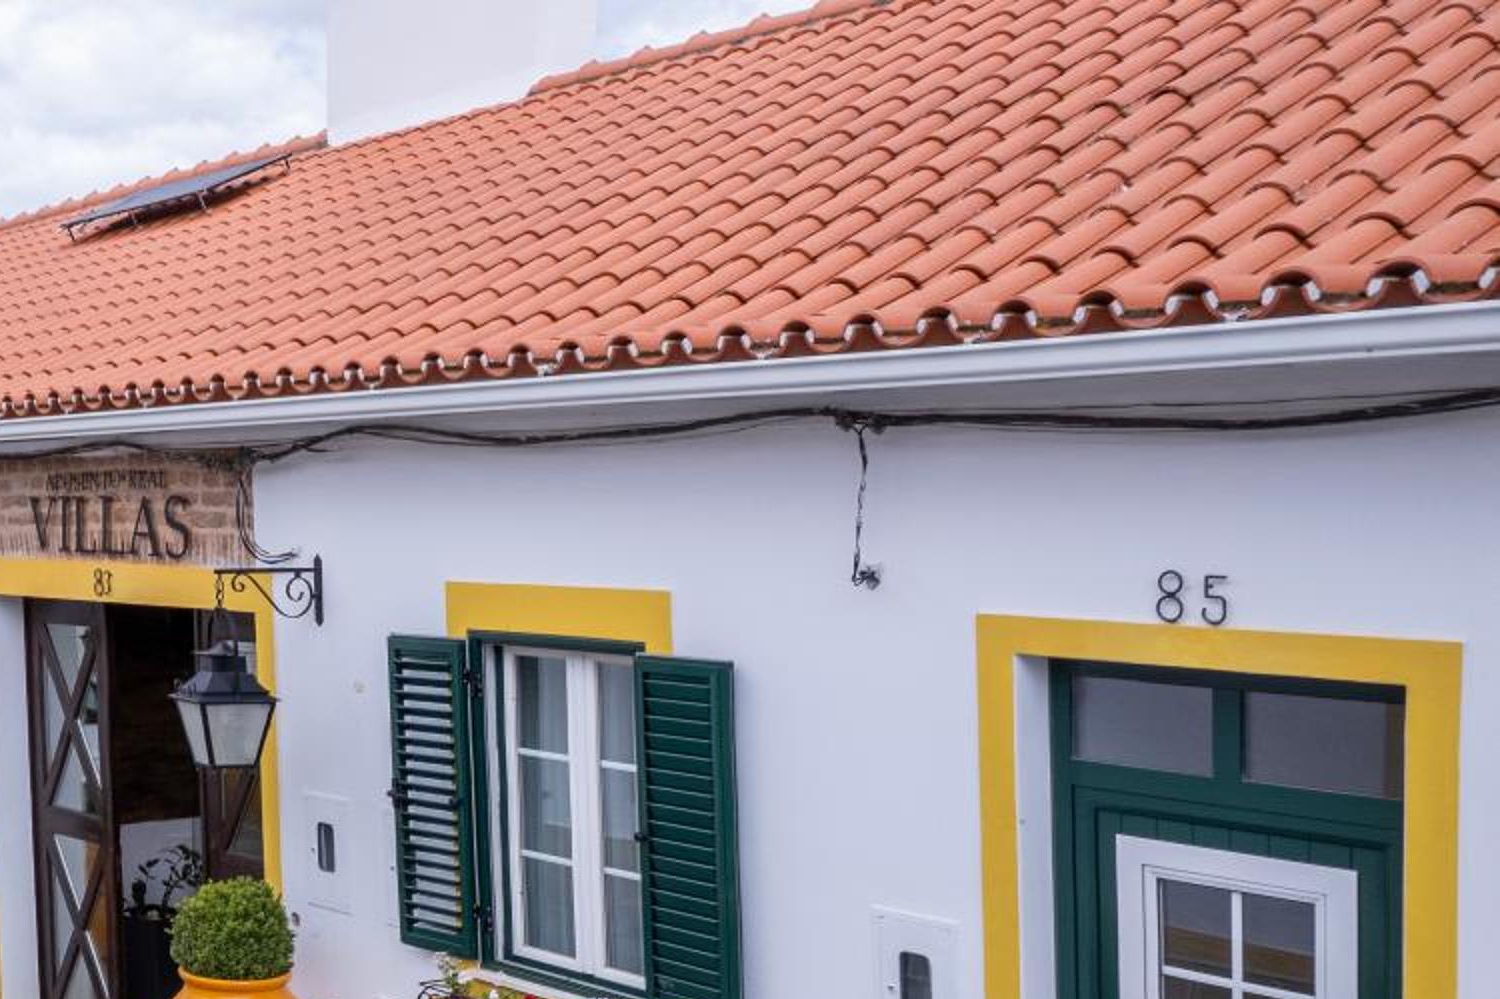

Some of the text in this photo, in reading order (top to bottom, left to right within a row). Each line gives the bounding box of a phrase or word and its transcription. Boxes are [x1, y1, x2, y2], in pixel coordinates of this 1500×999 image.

[29, 494, 192, 560] VILLAS
[93, 567, 113, 598] 83
[1156, 569, 1229, 626] 85
